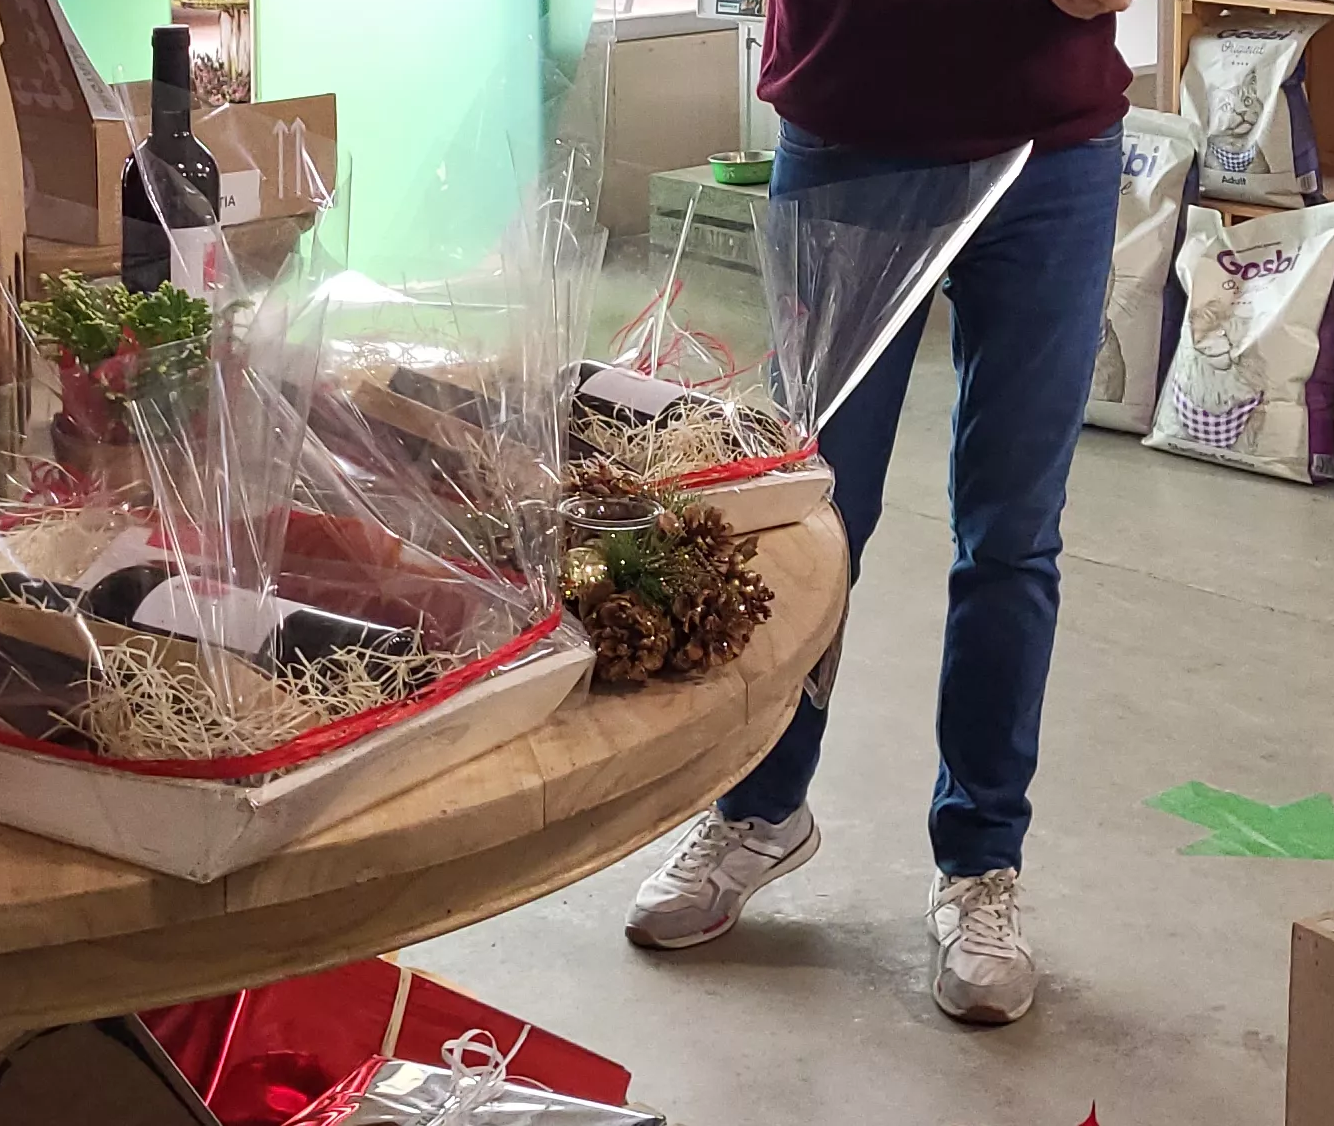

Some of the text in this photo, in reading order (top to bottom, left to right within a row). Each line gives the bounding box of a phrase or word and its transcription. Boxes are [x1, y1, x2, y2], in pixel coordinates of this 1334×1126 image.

[1123, 143, 1160, 178] bi
[1221, 175, 1247, 186] Adult
[1217, 245, 1302, 281] Gosbi
